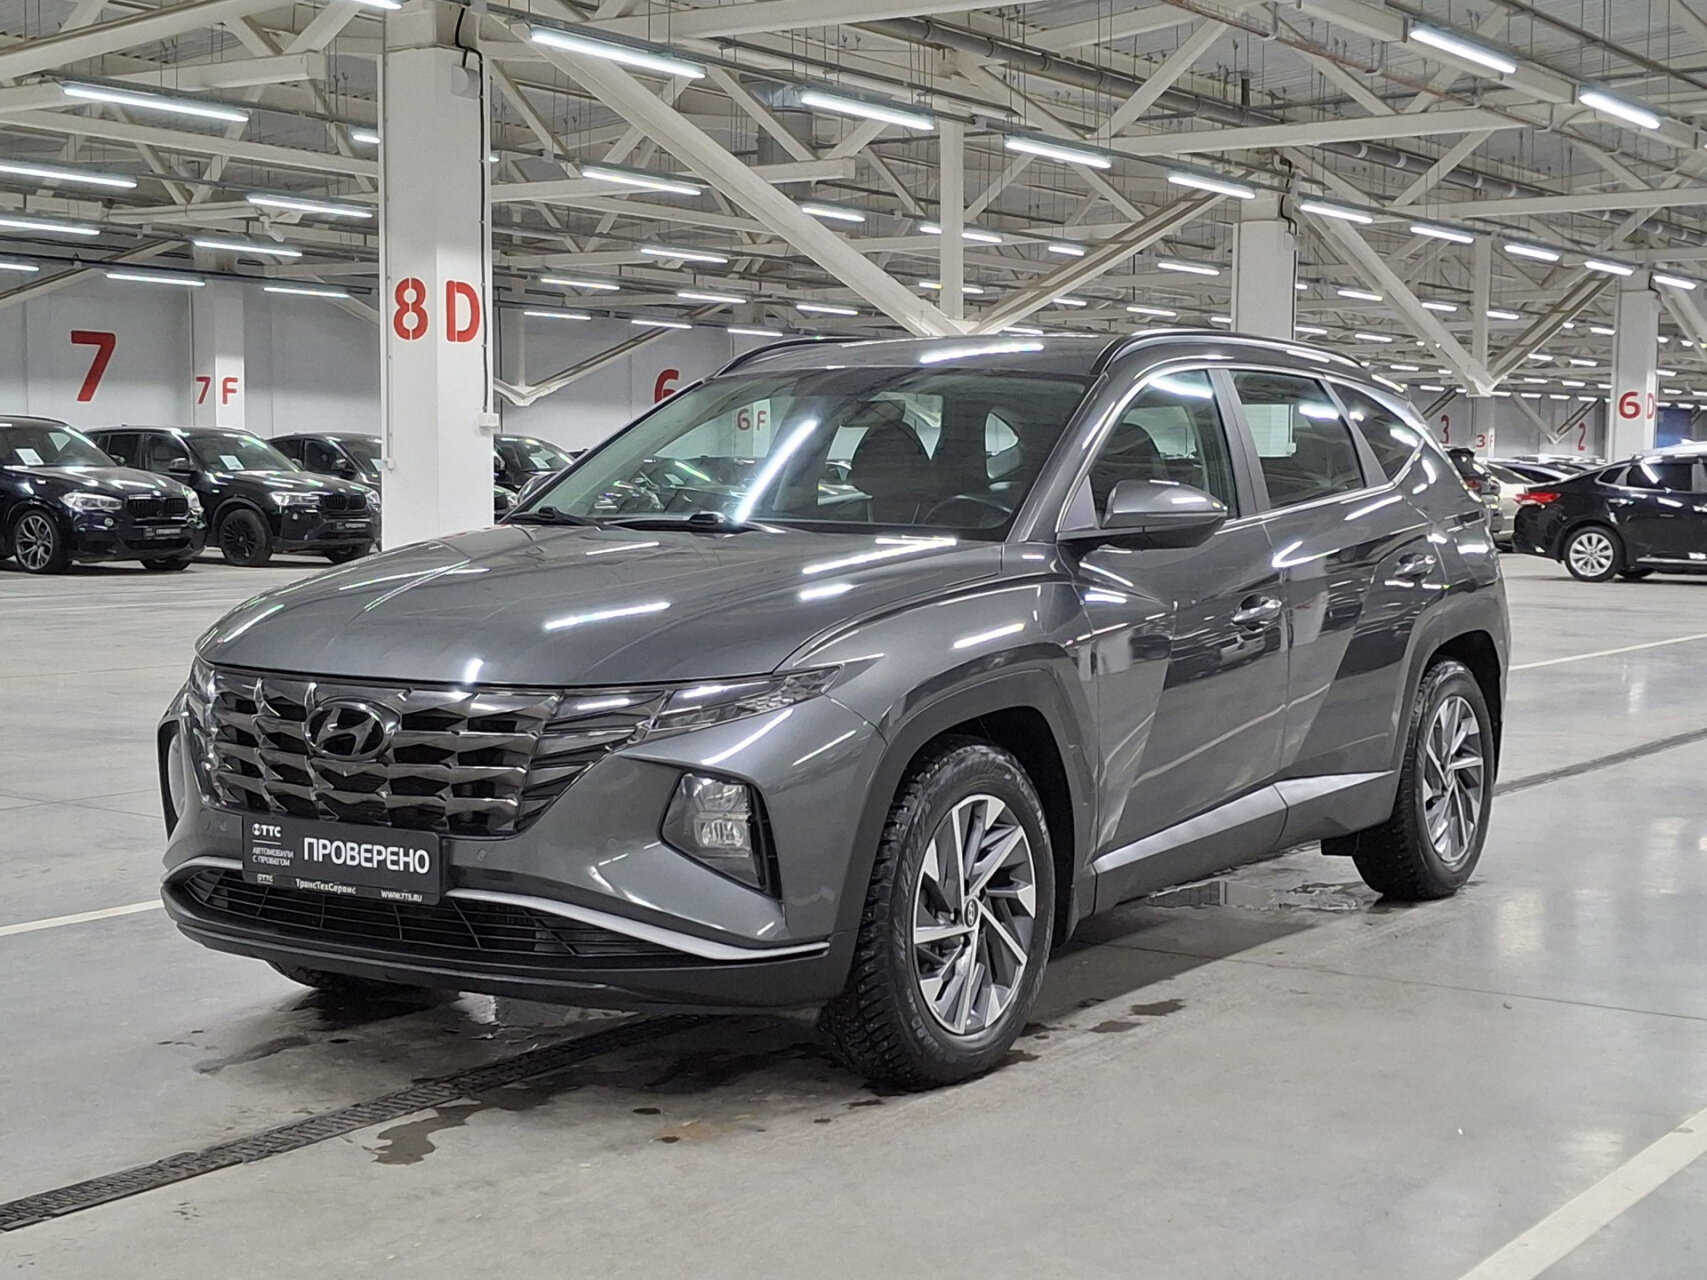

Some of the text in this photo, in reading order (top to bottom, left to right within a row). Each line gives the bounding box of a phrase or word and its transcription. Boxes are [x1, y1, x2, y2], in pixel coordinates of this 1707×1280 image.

[392, 277, 481, 343] 8 D
[70, 330, 117, 402] 7
[195, 376, 239, 405] 7 F
[1618, 391, 1642, 419] 6
[736, 407, 767, 431] 6 F
[1440, 414, 1450, 444] 3
[1476, 434, 1486, 448] 3
[1577, 422, 1587, 452] 2
[303, 836, 430, 874] ПРОВЕРЕНО
[295, 878, 357, 895] ТрансТехСервис
